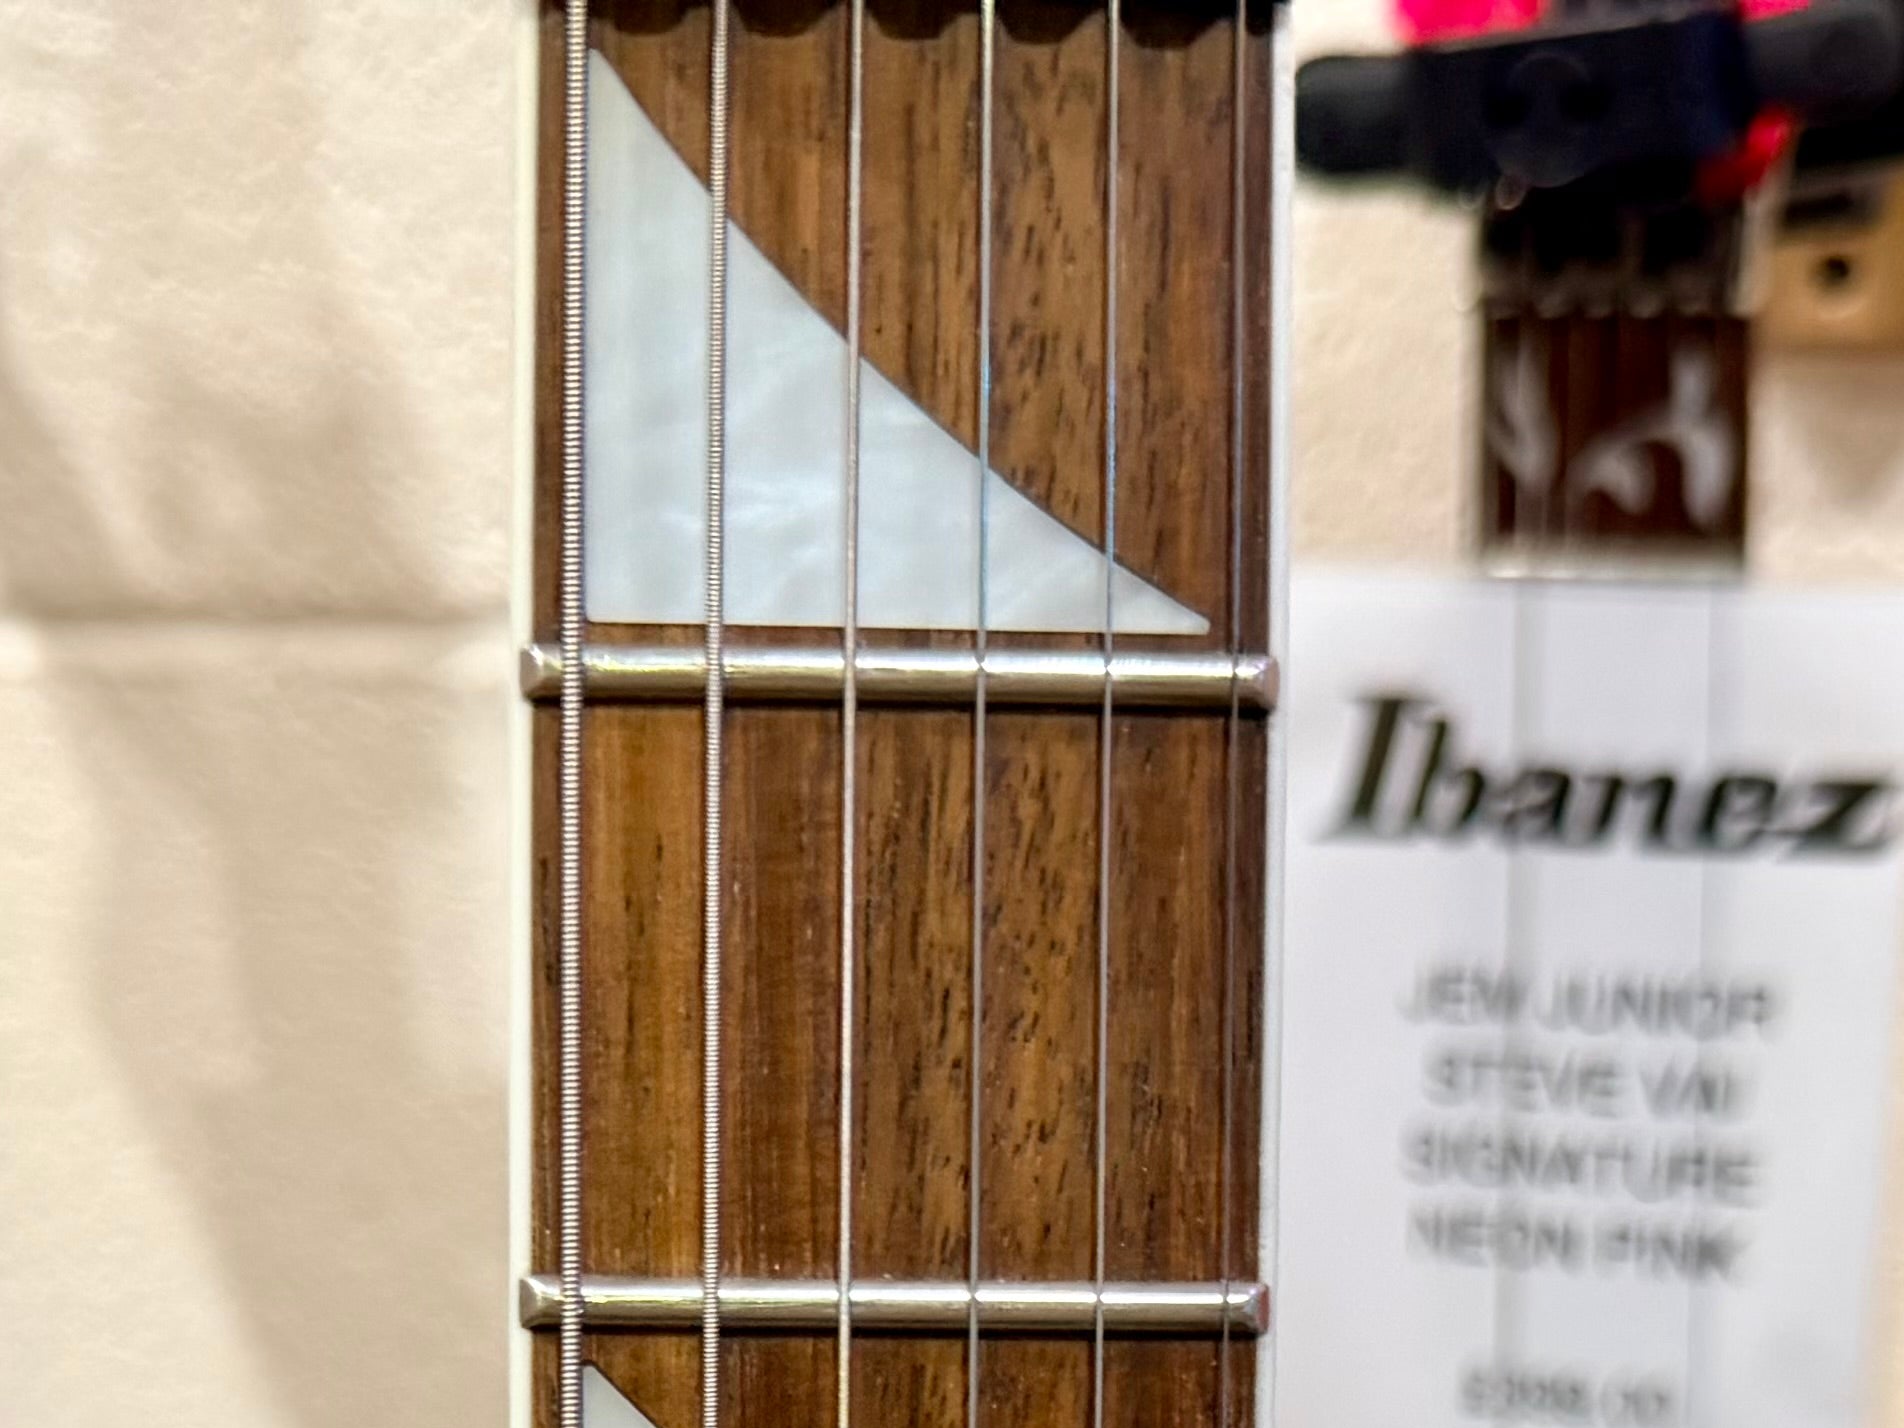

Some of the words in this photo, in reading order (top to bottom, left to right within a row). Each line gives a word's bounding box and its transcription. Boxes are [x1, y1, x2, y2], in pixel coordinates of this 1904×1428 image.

[1535, 975, 1778, 1040] JUNIOR
[1422, 1048, 1626, 1114] STEVE
[1398, 1126, 1766, 1205] SIGNATURE
